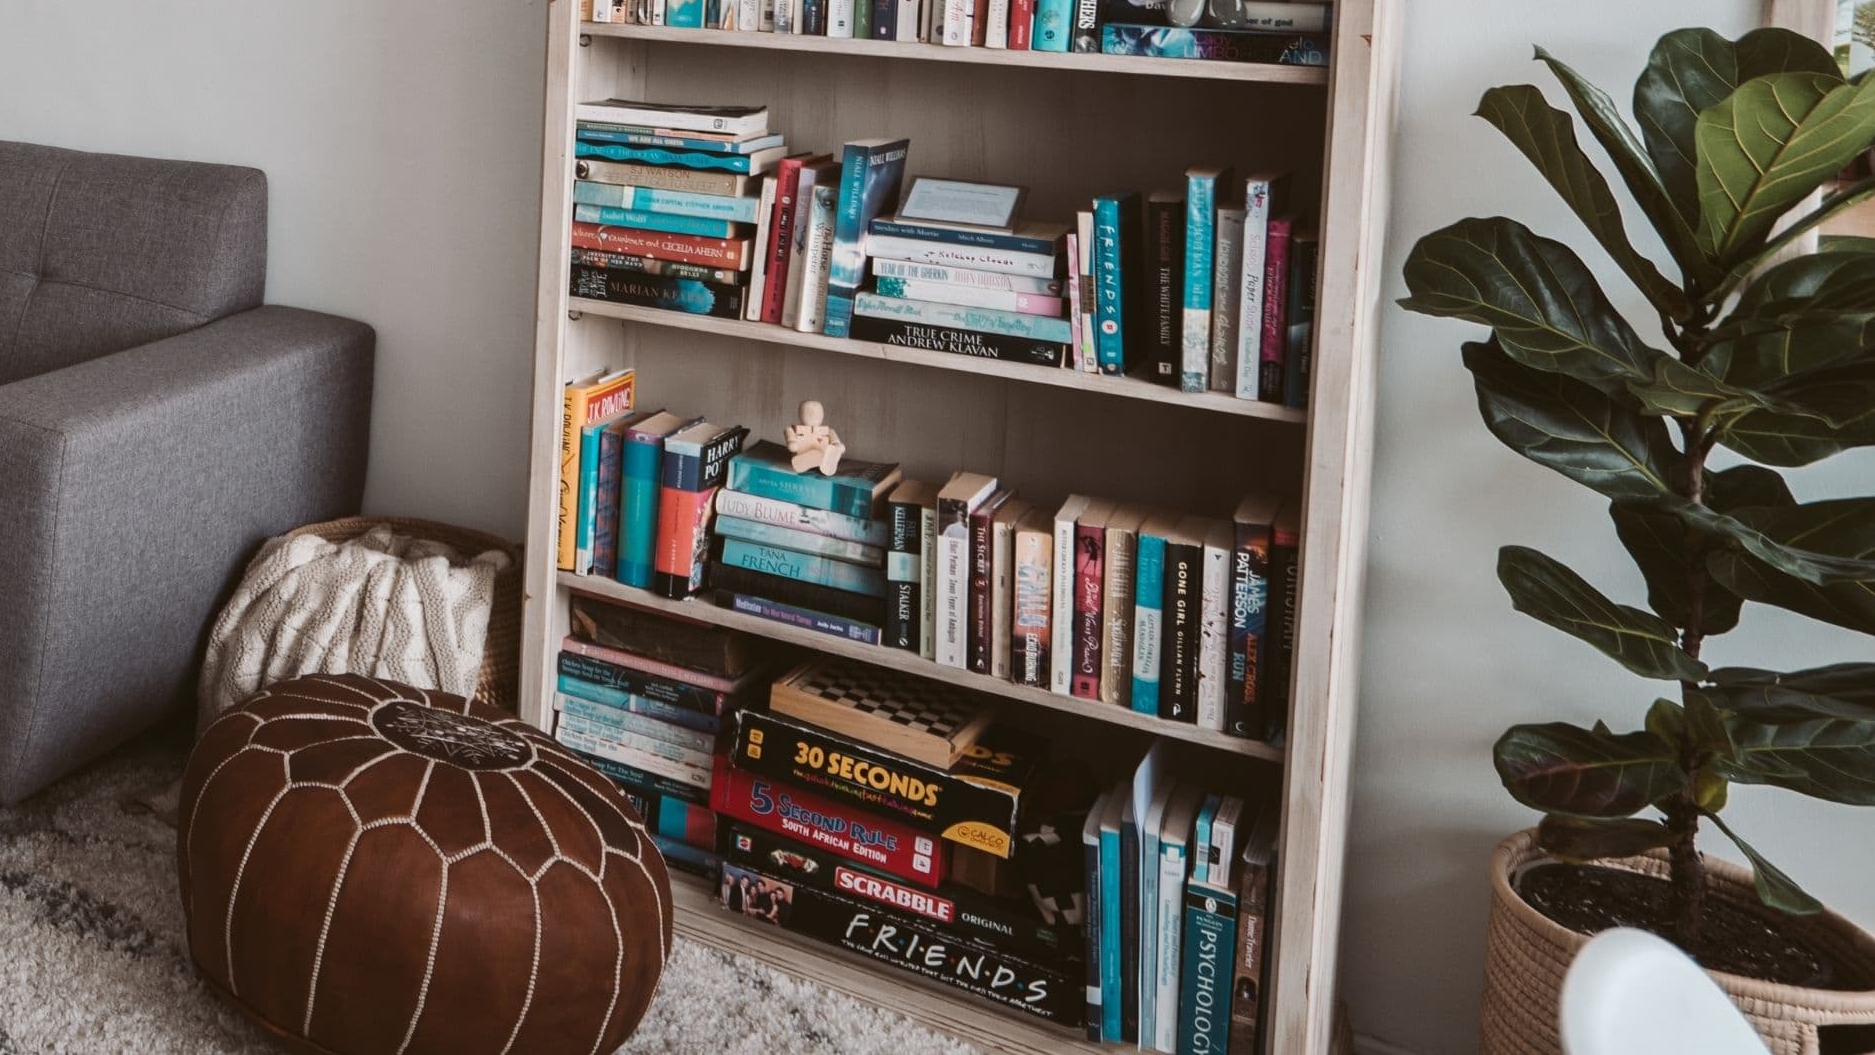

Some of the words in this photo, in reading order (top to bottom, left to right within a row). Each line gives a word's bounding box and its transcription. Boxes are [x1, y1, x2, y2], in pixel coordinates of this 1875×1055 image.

[951, 1, 962, 22] Am
[646, 168, 691, 179] WATSON
[854, 155, 863, 178] NIALL
[849, 181, 861, 220] WILLIAMS
[603, 212, 624, 221] Isabel
[626, 214, 647, 223] Wolff
[823, 226, 832, 242] The
[901, 226, 915, 234] with
[917, 228, 939, 238] Morrie
[662, 242, 694, 254] CECELIA
[696, 246, 723, 257] AHERN
[810, 222, 825, 274] Whisperer
[819, 242, 832, 273] Horse
[938, 250, 976, 262] Ketchup
[1192, 226, 1205, 277] HOFFMAN
[880, 263, 895, 274] YEAR
[897, 263, 906, 275] OF
[908, 265, 919, 277] THE
[954, 271, 975, 285] JOHN
[1160, 267, 1170, 284] THE
[596, 274, 607, 297] LIFE
[611, 282, 658, 297] MARIAN
[1246, 273, 1259, 303] Paper
[1160, 286, 1170, 314] WHITE
[1160, 315, 1170, 346] FAMILY
[1245, 304, 1257, 332] Stone
[888, 334, 944, 350] ANDREW
[949, 342, 999, 358] KLAVAN
[904, 325, 938, 340] TRUE
[940, 330, 983, 346] CRIME
[601, 388, 631, 418] ROWLING
[706, 436, 739, 463] HARRY
[722, 496, 751, 515] JUDY
[755, 502, 796, 524] BLUME
[894, 506, 906, 551] KELLERMAN
[977, 526, 987, 542] THE
[742, 554, 801, 578] FRENCH
[759, 547, 787, 562] TANA
[977, 544, 986, 574] SECRET
[1178, 561, 1187, 595] GONE
[1234, 552, 1249, 628] PATTERSON
[899, 584, 911, 620] STALKER
[1248, 570, 1260, 614] JAMES
[1177, 600, 1186, 625] GIRL
[1026, 633, 1038, 650] ECHO
[1246, 633, 1256, 662] ALEX
[1025, 651, 1037, 682] BURNING
[1232, 652, 1245, 682] RUN
[794, 741, 825, 769] 30
[827, 752, 940, 807] SECONDS
[750, 779, 774, 815] 5
[778, 794, 847, 833] SECOND
[849, 822, 898, 851] RULE
[782, 817, 811, 838] SOUTH
[812, 829, 850, 852] AFRICAN
[852, 843, 888, 863] EDITION
[839, 872, 951, 921] SCRABBLE
[961, 913, 1014, 936] ORIGINAL
[1246, 915, 1258, 938] Dame
